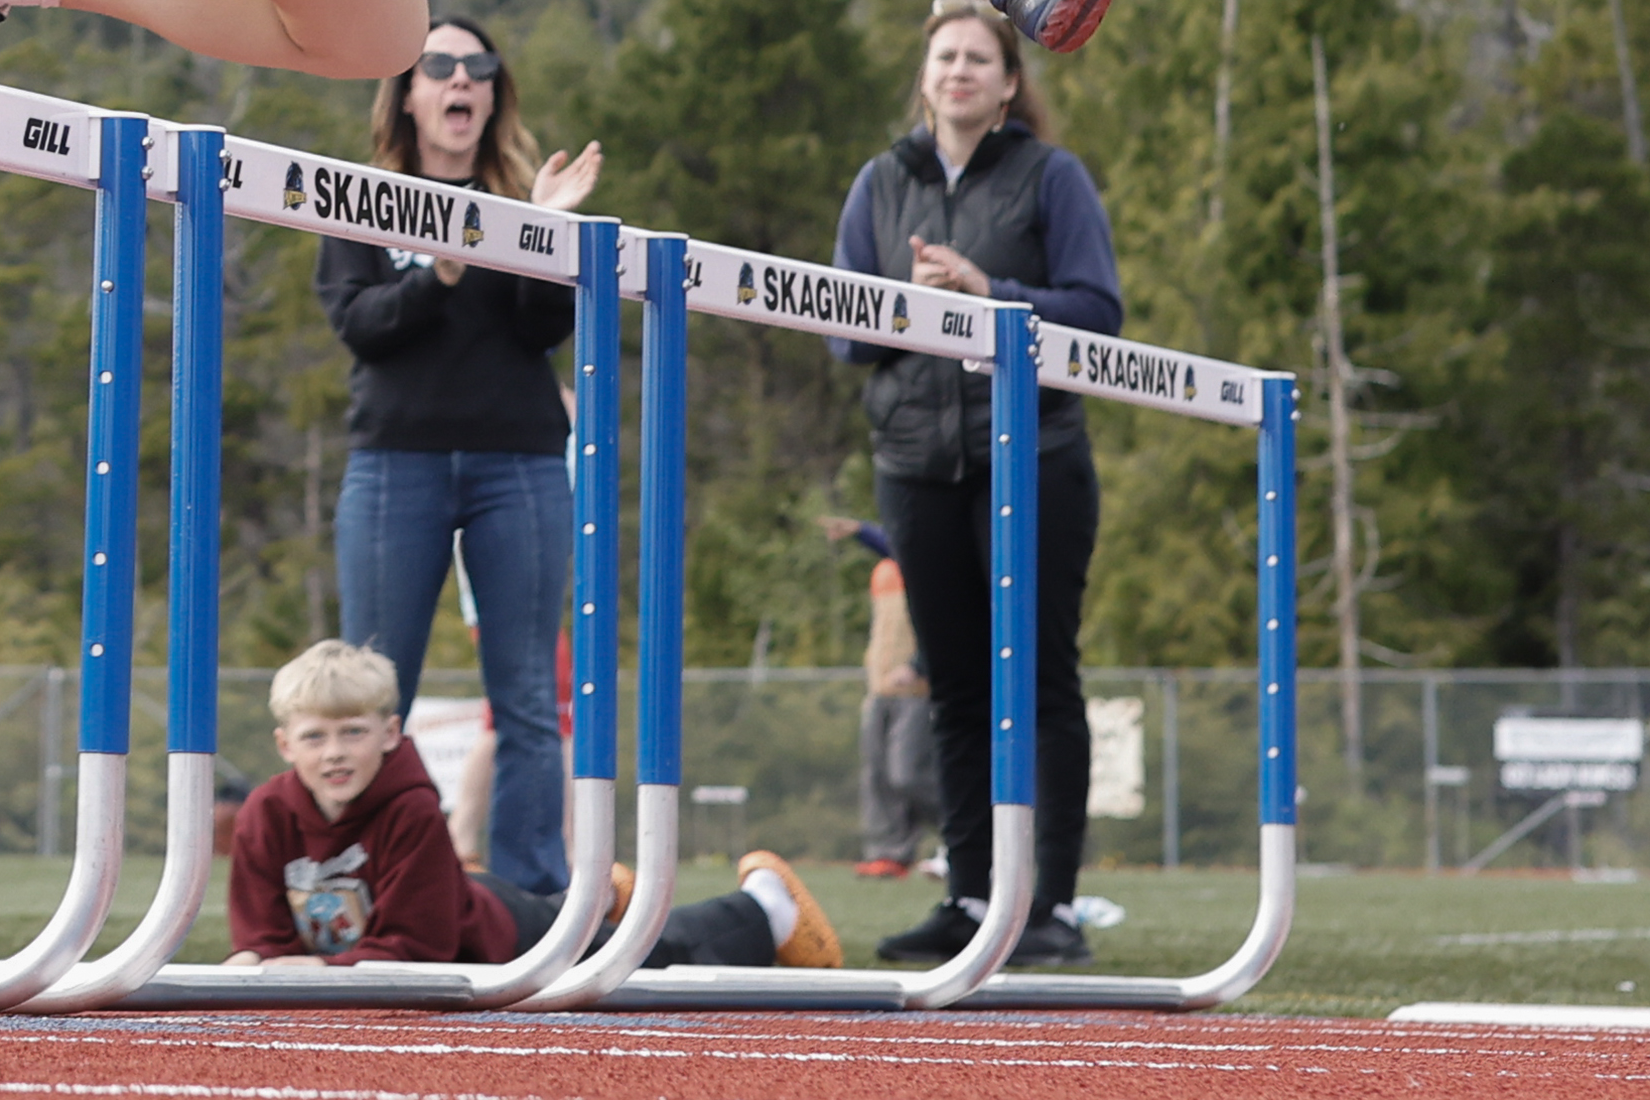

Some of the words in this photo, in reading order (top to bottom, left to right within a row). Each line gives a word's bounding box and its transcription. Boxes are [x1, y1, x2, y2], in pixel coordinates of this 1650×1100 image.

[23, 117, 70, 155] GILL
[314, 167, 454, 243] SKAGWAY
[519, 223, 554, 255] GILL
[764, 266, 884, 330] SKAGWAY
[941, 310, 973, 338] GILL
[1087, 342, 1179, 398] SKAGWAY
